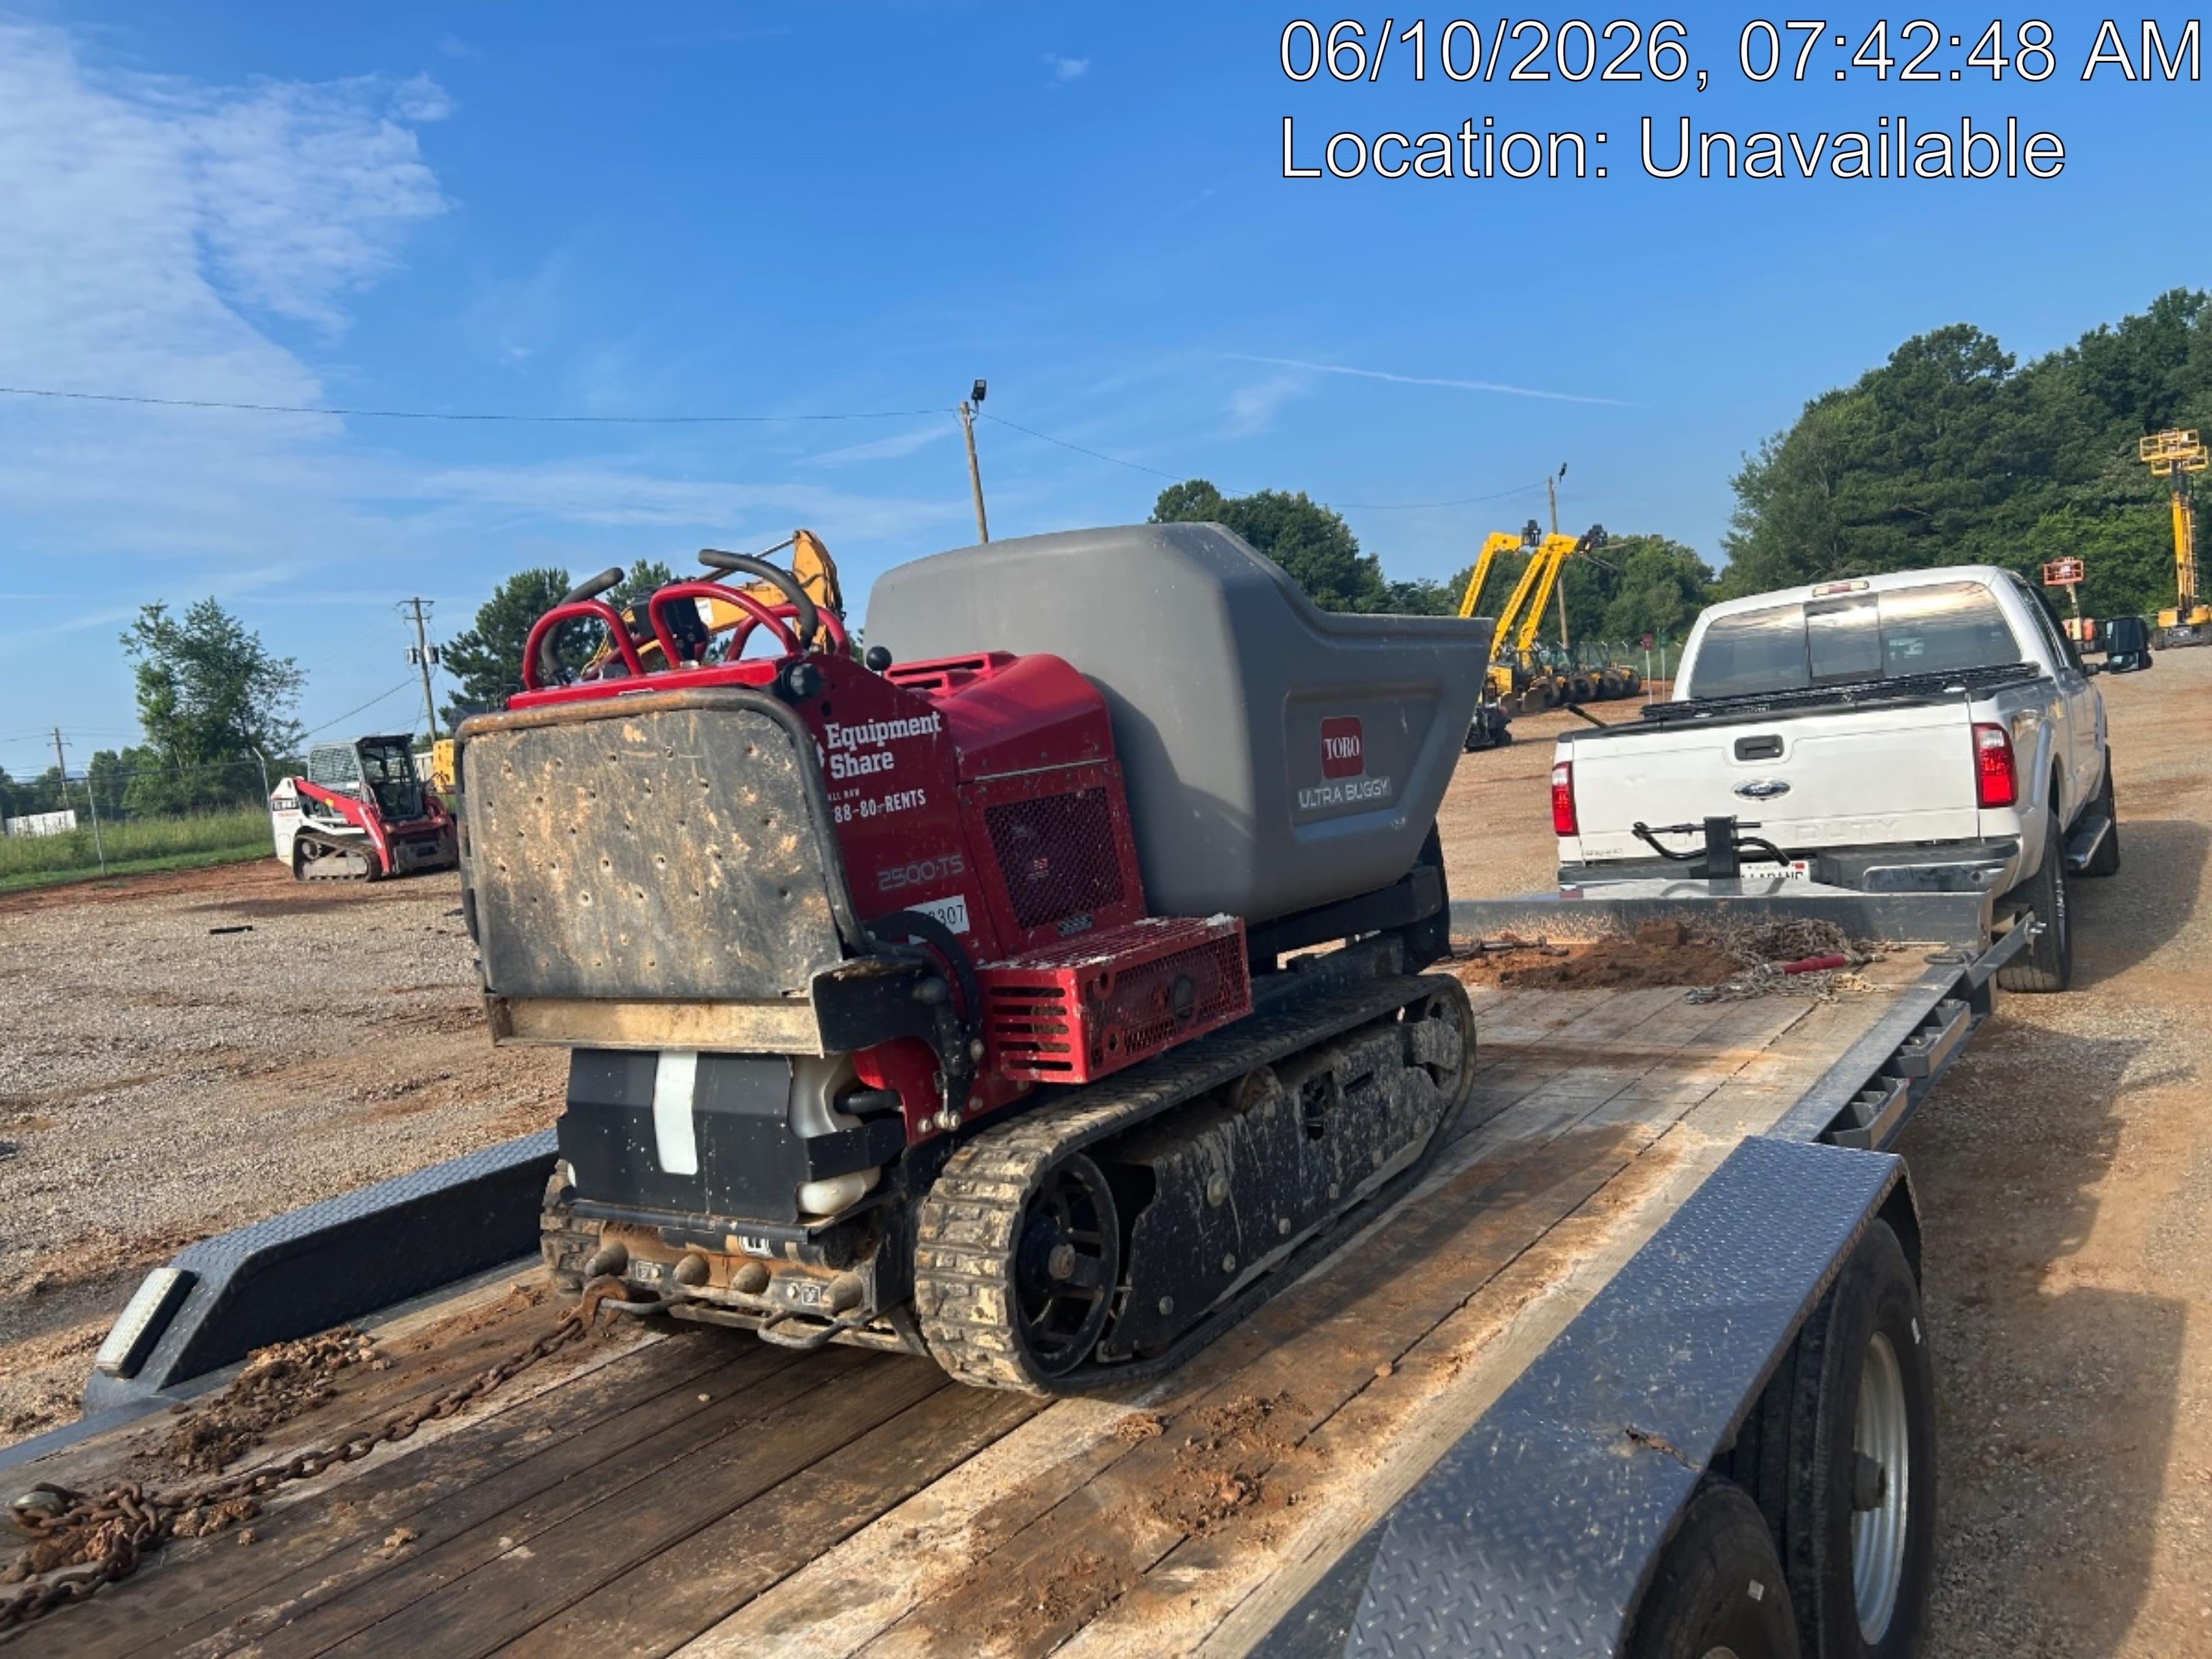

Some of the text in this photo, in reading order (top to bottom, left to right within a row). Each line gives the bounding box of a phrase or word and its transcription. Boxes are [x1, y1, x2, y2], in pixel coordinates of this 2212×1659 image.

[825, 711, 942, 751] Equipment
[1325, 735, 1359, 759] TORO
[831, 751, 895, 780] Share
[1299, 778, 1389, 808] ULTRA BUGGY
